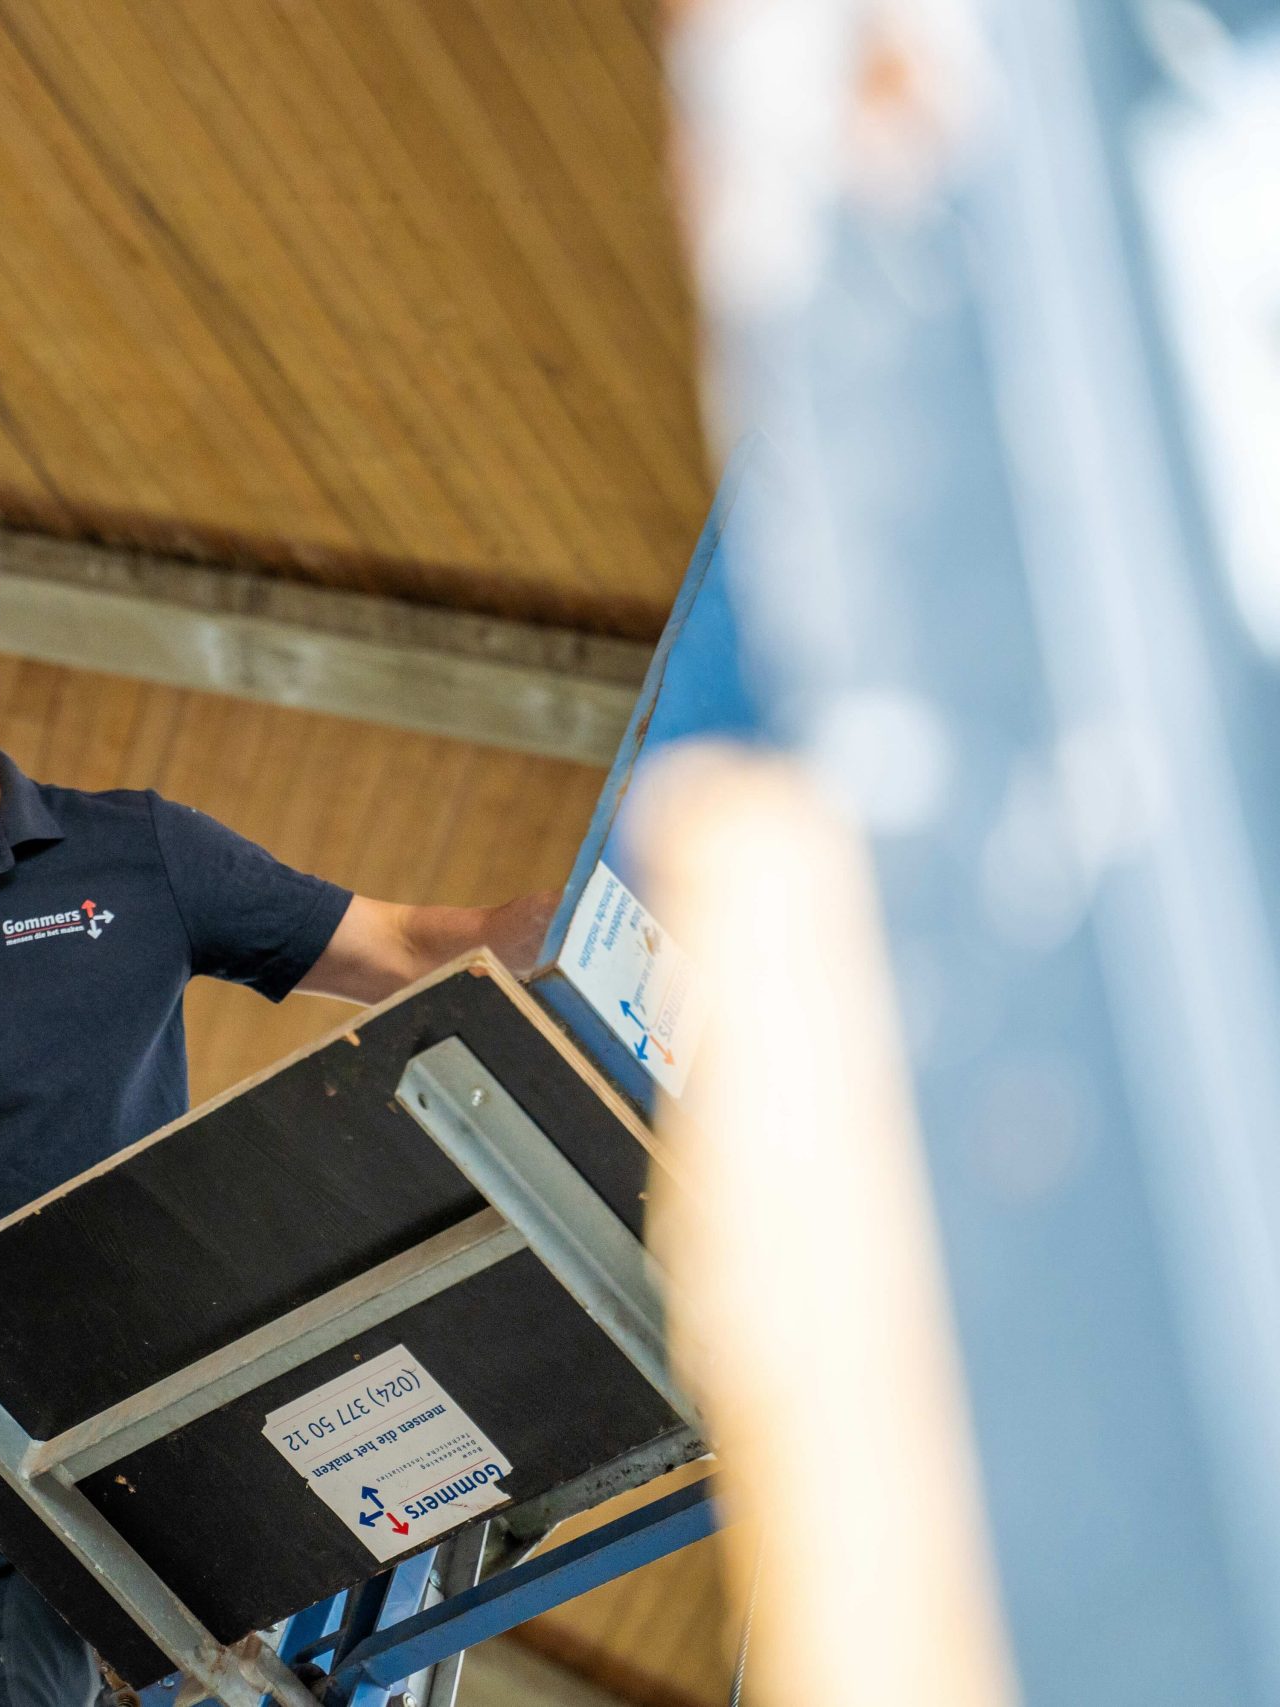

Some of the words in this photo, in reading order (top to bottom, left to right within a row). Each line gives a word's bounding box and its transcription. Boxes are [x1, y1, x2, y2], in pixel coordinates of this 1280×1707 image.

[2, 910, 81, 935] Gommers
[6, 935, 34, 946] mensen
[34, 931, 46, 940] die
[47, 928, 60, 937] het
[60, 925, 85, 934] maken
[366, 1369, 421, 1407] (024)
[336, 1398, 370, 1426] 377
[398, 1404, 447, 1433] mensen
[308, 1416, 336, 1438] 50
[376, 1430, 397, 1444] die
[282, 1430, 309, 1451] 12
[354, 1441, 379, 1457] het
[426, 1432, 470, 1457] Technische
[462, 1446, 483, 1459] Bouw
[312, 1452, 354, 1477] maken
[420, 1439, 477, 1470] Dakbedekking
[404, 1463, 505, 1519] Gommers
